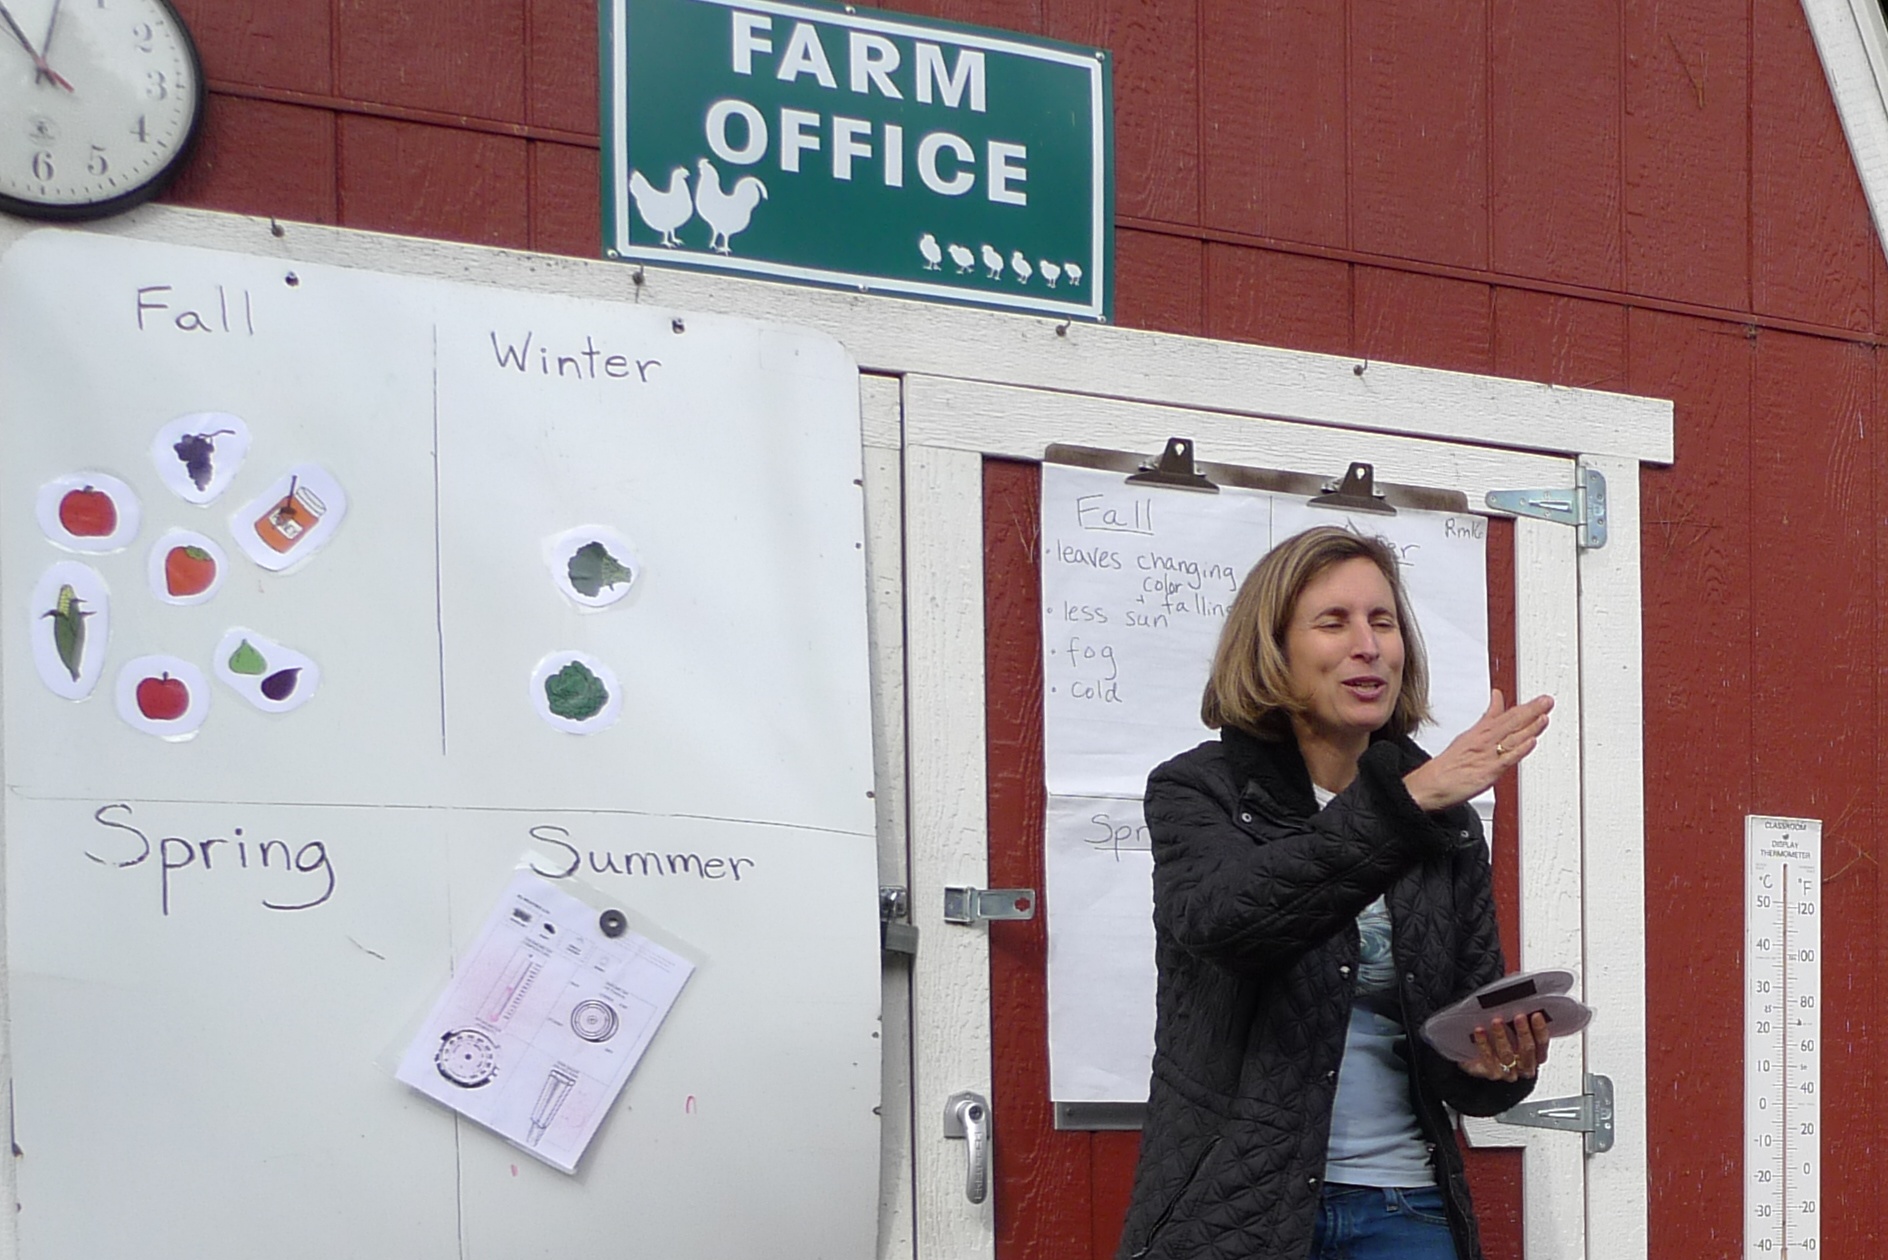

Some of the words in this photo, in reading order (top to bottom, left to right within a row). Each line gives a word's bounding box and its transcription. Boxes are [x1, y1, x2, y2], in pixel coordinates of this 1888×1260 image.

[133, 22, 153, 53] 2
[732, 10, 987, 113] FARM
[146, 70, 168, 101] 3
[130, 114, 149, 143] 4
[87, 144, 109, 176] 5
[705, 99, 1027, 206] OFFICE
[32, 151, 54, 181] 6
[137, 284, 254, 336] Fall
[490, 331, 662, 383] Winter
[1076, 493, 1153, 531] Fall
[1056, 539, 1122, 569] leaves
[1136, 552, 1237, 591] changing
[1143, 573, 1183, 595] color
[1063, 600, 1109, 624] less
[1125, 610, 1169, 628] sun
[1067, 636, 1117, 681] fog
[1071, 680, 1123, 704] cold
[1084, 813, 1149, 862] Spr
[1764, 821, 1807, 831] CLASSROOM
[528, 824, 755, 881] Summer
[1760, 849, 1811, 859] THERMOMETER
[1771, 840, 1799, 849] DISPLAY
[84, 803, 335, 916] Spring
[1756, 895, 1770, 908] 50
[1797, 902, 1815, 915] 120
[1756, 938, 1770, 951] 40
[1797, 950, 1815, 962] 100
[1756, 980, 1770, 993] 30
[1800, 995, 1815, 1008] 80
[1756, 1021, 1770, 1034] 20
[1800, 1039, 1815, 1052] 60
[1757, 1059, 1770, 1072] 10
[1800, 1081, 1815, 1094] 40
[1759, 1097, 1767, 1110] 0
[1800, 1122, 1815, 1135] 20
[1803, 1162, 1811, 1175] 0
